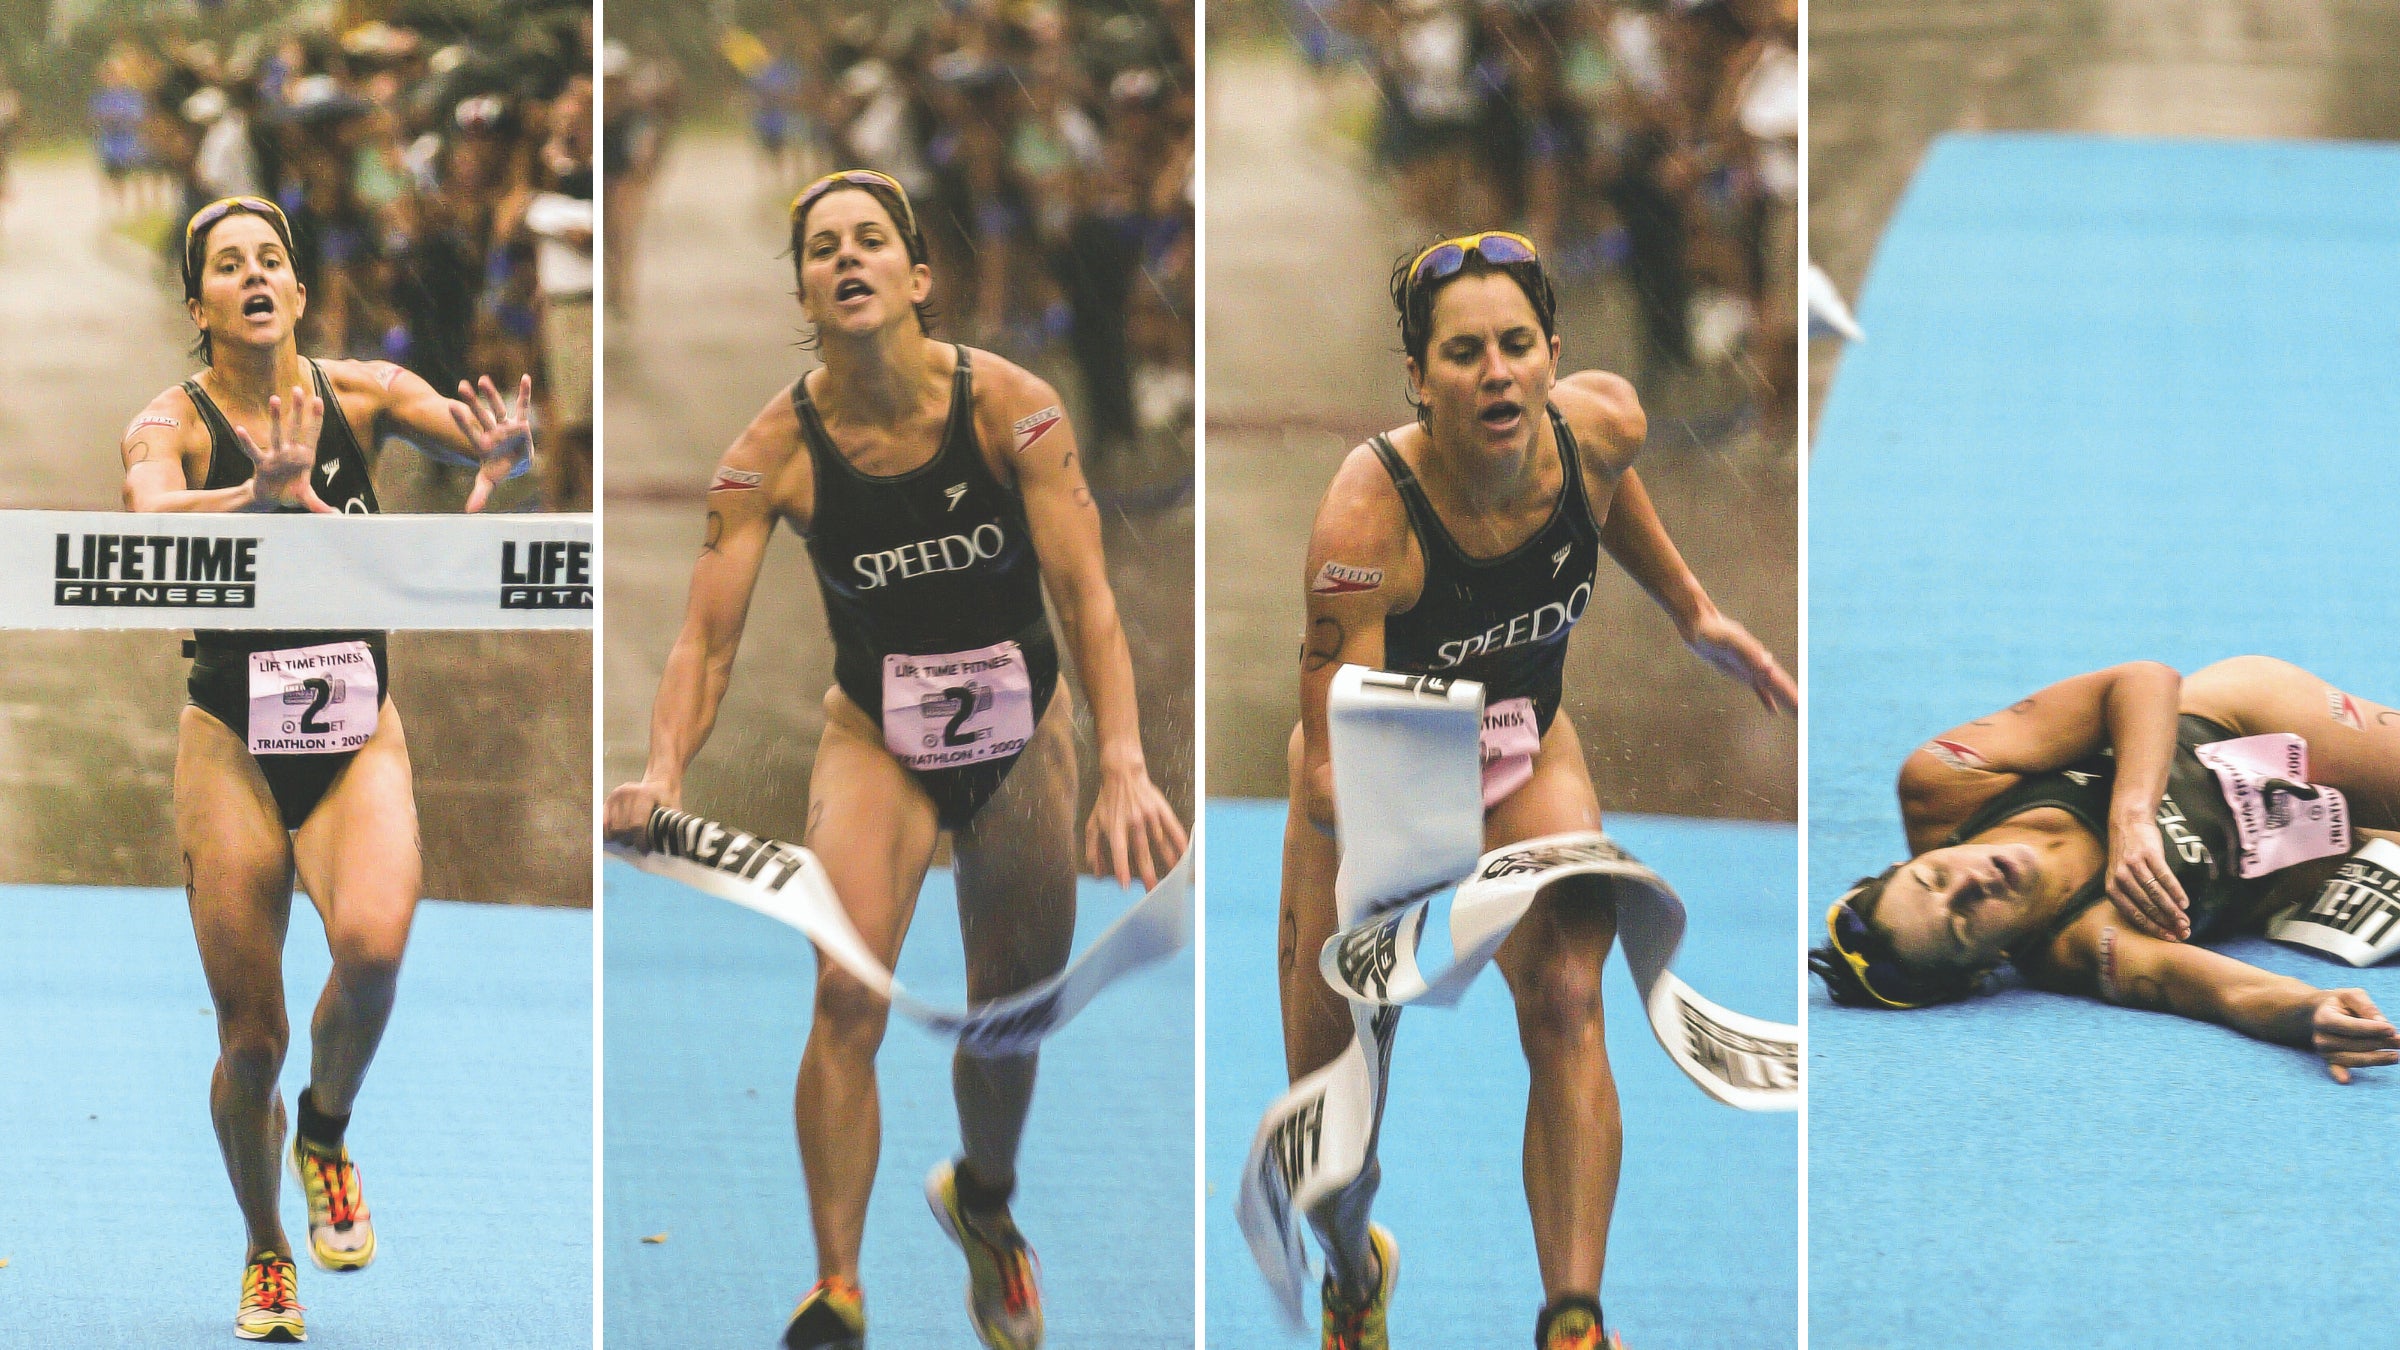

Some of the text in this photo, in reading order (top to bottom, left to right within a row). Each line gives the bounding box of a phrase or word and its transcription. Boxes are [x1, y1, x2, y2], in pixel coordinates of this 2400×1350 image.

[55, 533, 258, 582] LIFETIME
[501, 541, 593, 585] LIFE
[852, 522, 1003, 591] SPEEDO
[63, 586, 246, 603] FITNESS
[1430, 582, 1591, 671] SPEEDO
[285, 658, 316, 671] TIME
[320, 652, 364, 667] FITNESS
[301, 677, 331, 734] 2
[943, 686, 976, 747] 2
[257, 738, 326, 749] TRIATHLON
[989, 738, 1026, 755] 2002
